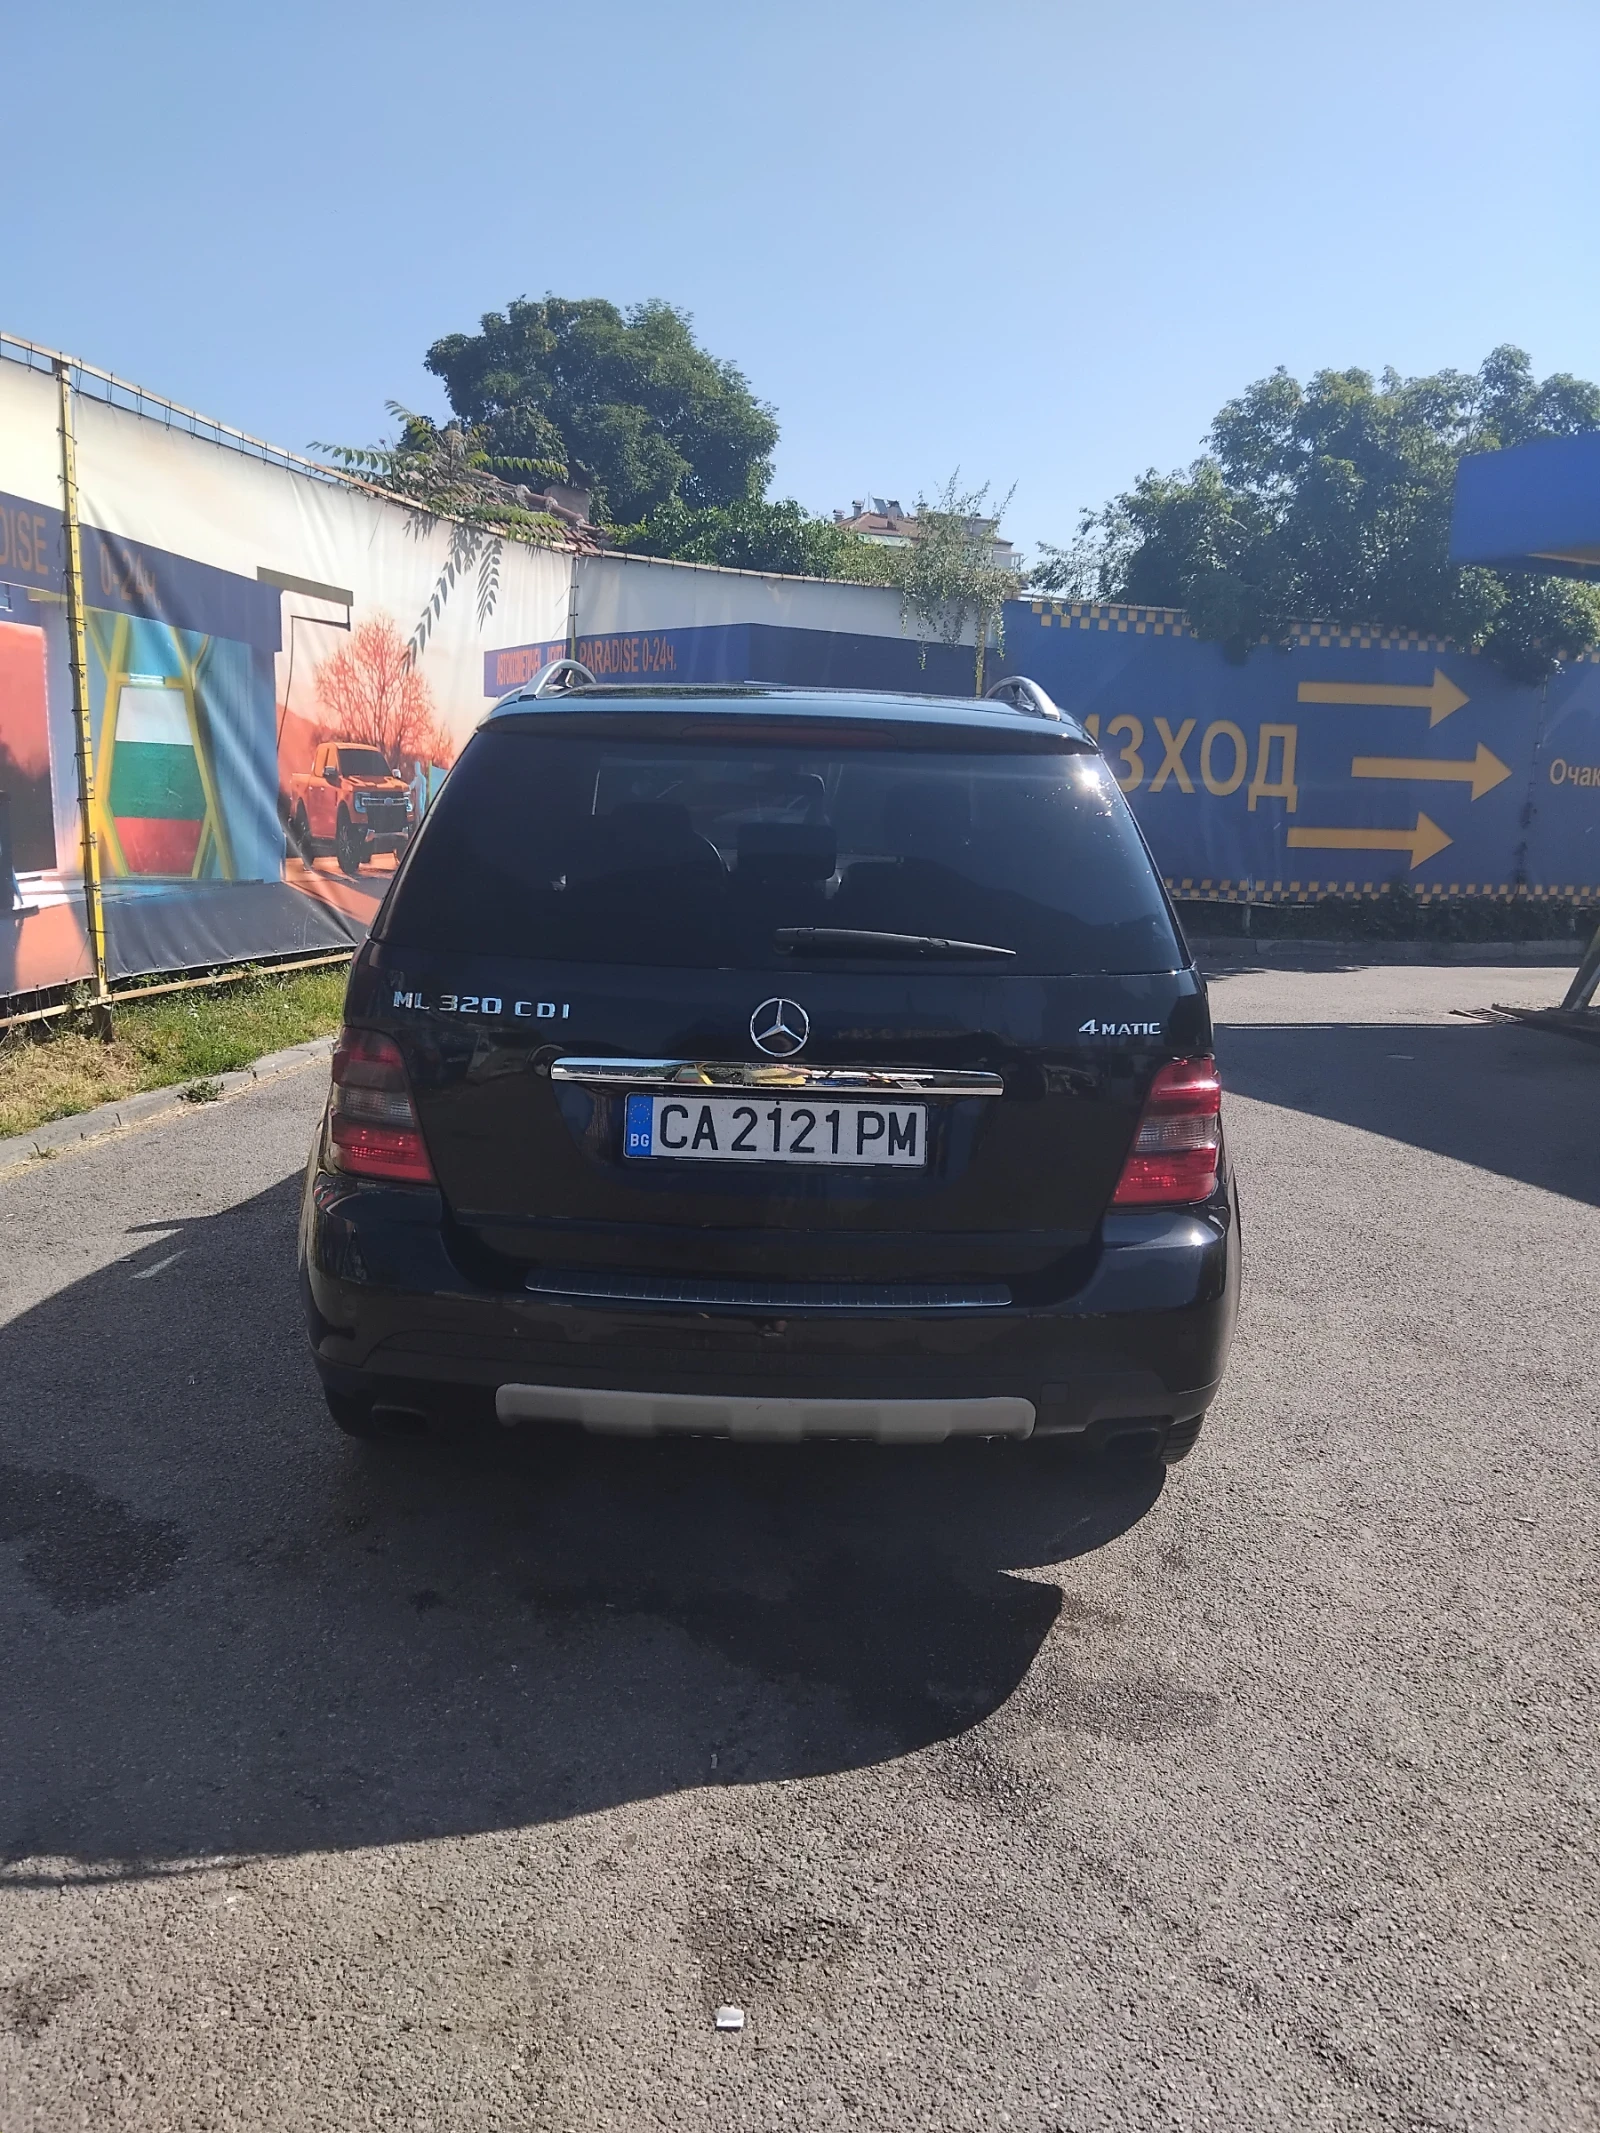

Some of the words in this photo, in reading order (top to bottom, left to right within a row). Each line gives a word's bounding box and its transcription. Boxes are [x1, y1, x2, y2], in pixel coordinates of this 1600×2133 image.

[580, 638, 640, 674] PARADISE
[1085, 713, 1298, 813] ЗХОД
[392, 990, 430, 1010] ML
[438, 994, 503, 1015] 320
[514, 1001, 570, 1020] CDI
[1078, 1018, 1161, 1036] 4MATIC
[629, 1133, 650, 1148] BG
[659, 1104, 719, 1151] CA
[730, 1105, 840, 1155] 2121
[856, 1110, 918, 1158] PM
